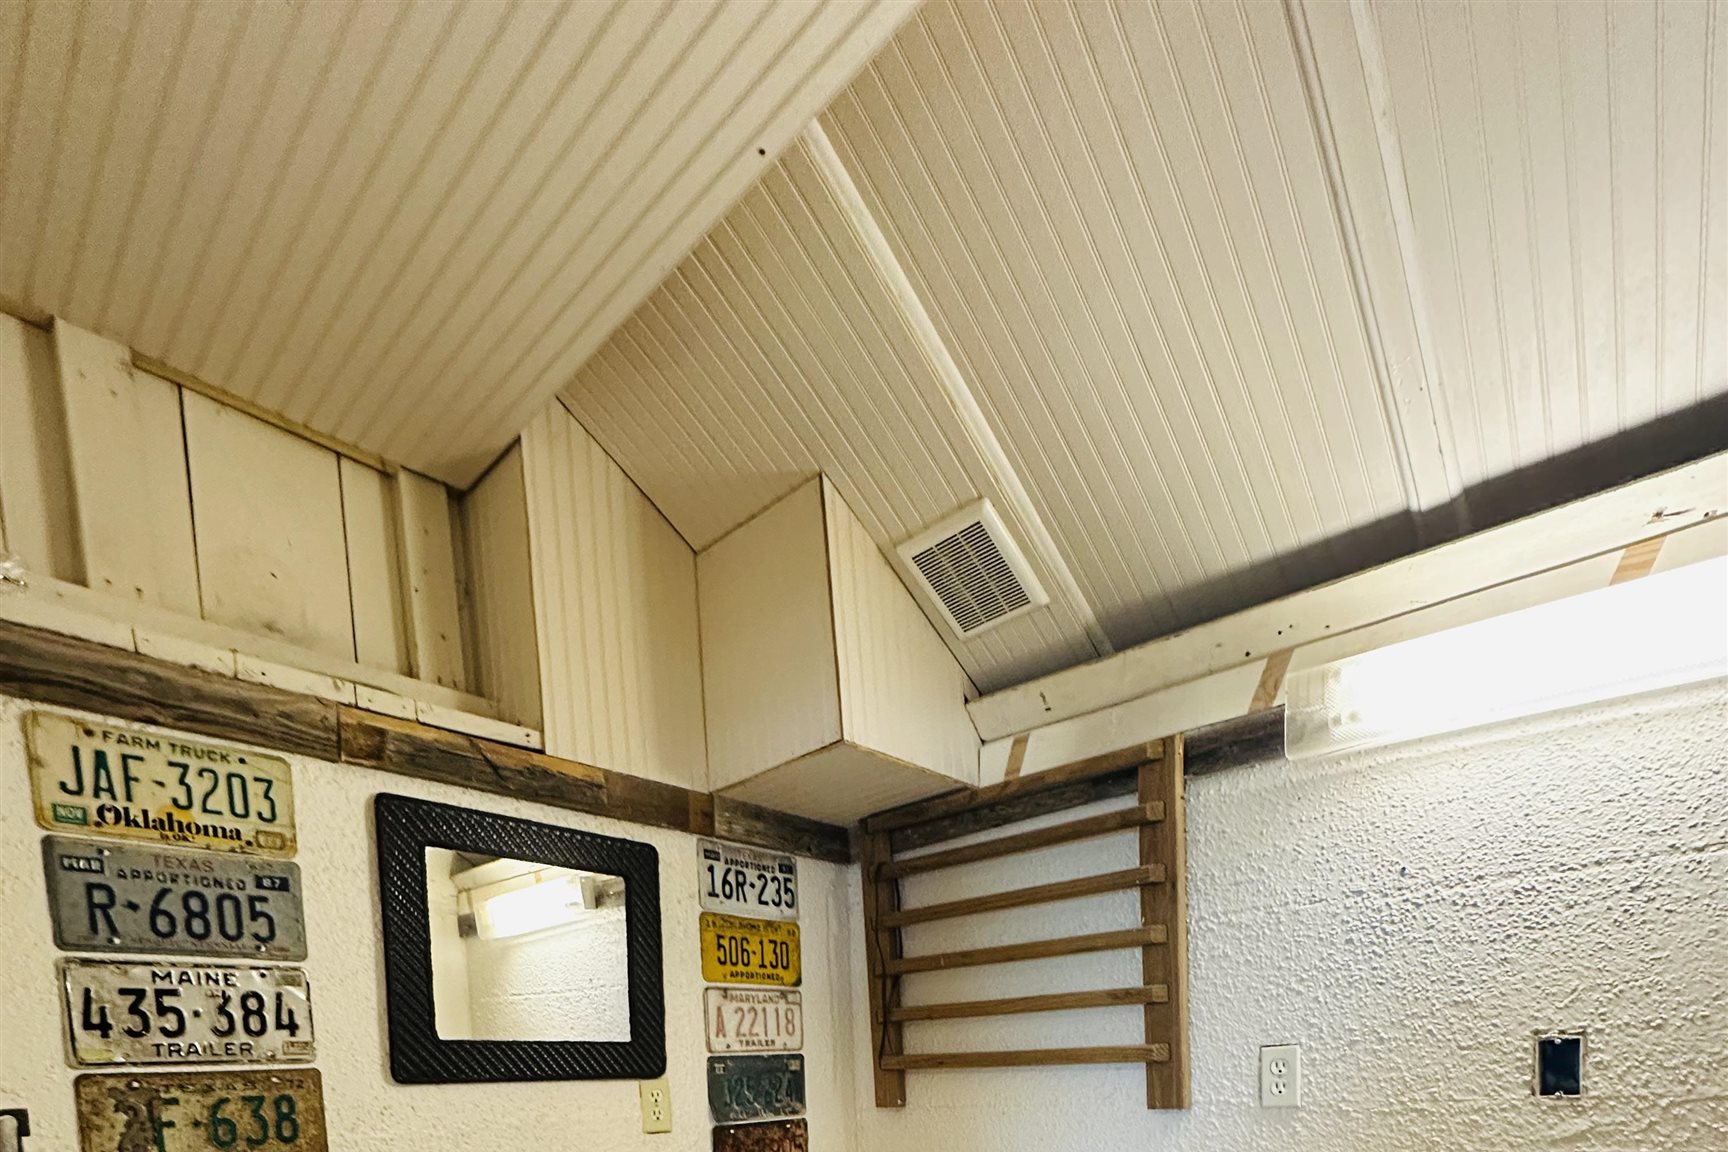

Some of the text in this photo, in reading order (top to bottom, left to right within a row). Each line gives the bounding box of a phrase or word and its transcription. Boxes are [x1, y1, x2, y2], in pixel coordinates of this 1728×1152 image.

[102, 730, 231, 764] FARM TRUCK
[59, 745, 278, 824] JAF-3203
[95, 803, 242, 841] Oklahoma
[152, 855, 214, 873] TEXAS
[724, 857, 776, 874] APPORTIONED
[117, 867, 248, 891] APPORTIONED
[151, 970, 239, 987] MAINE
[729, 970, 779, 982] APPORTIONED
[729, 990, 780, 1004] MARYLAND
[716, 1006, 796, 1038] A 22118
[151, 1042, 254, 1057] TRAILER
